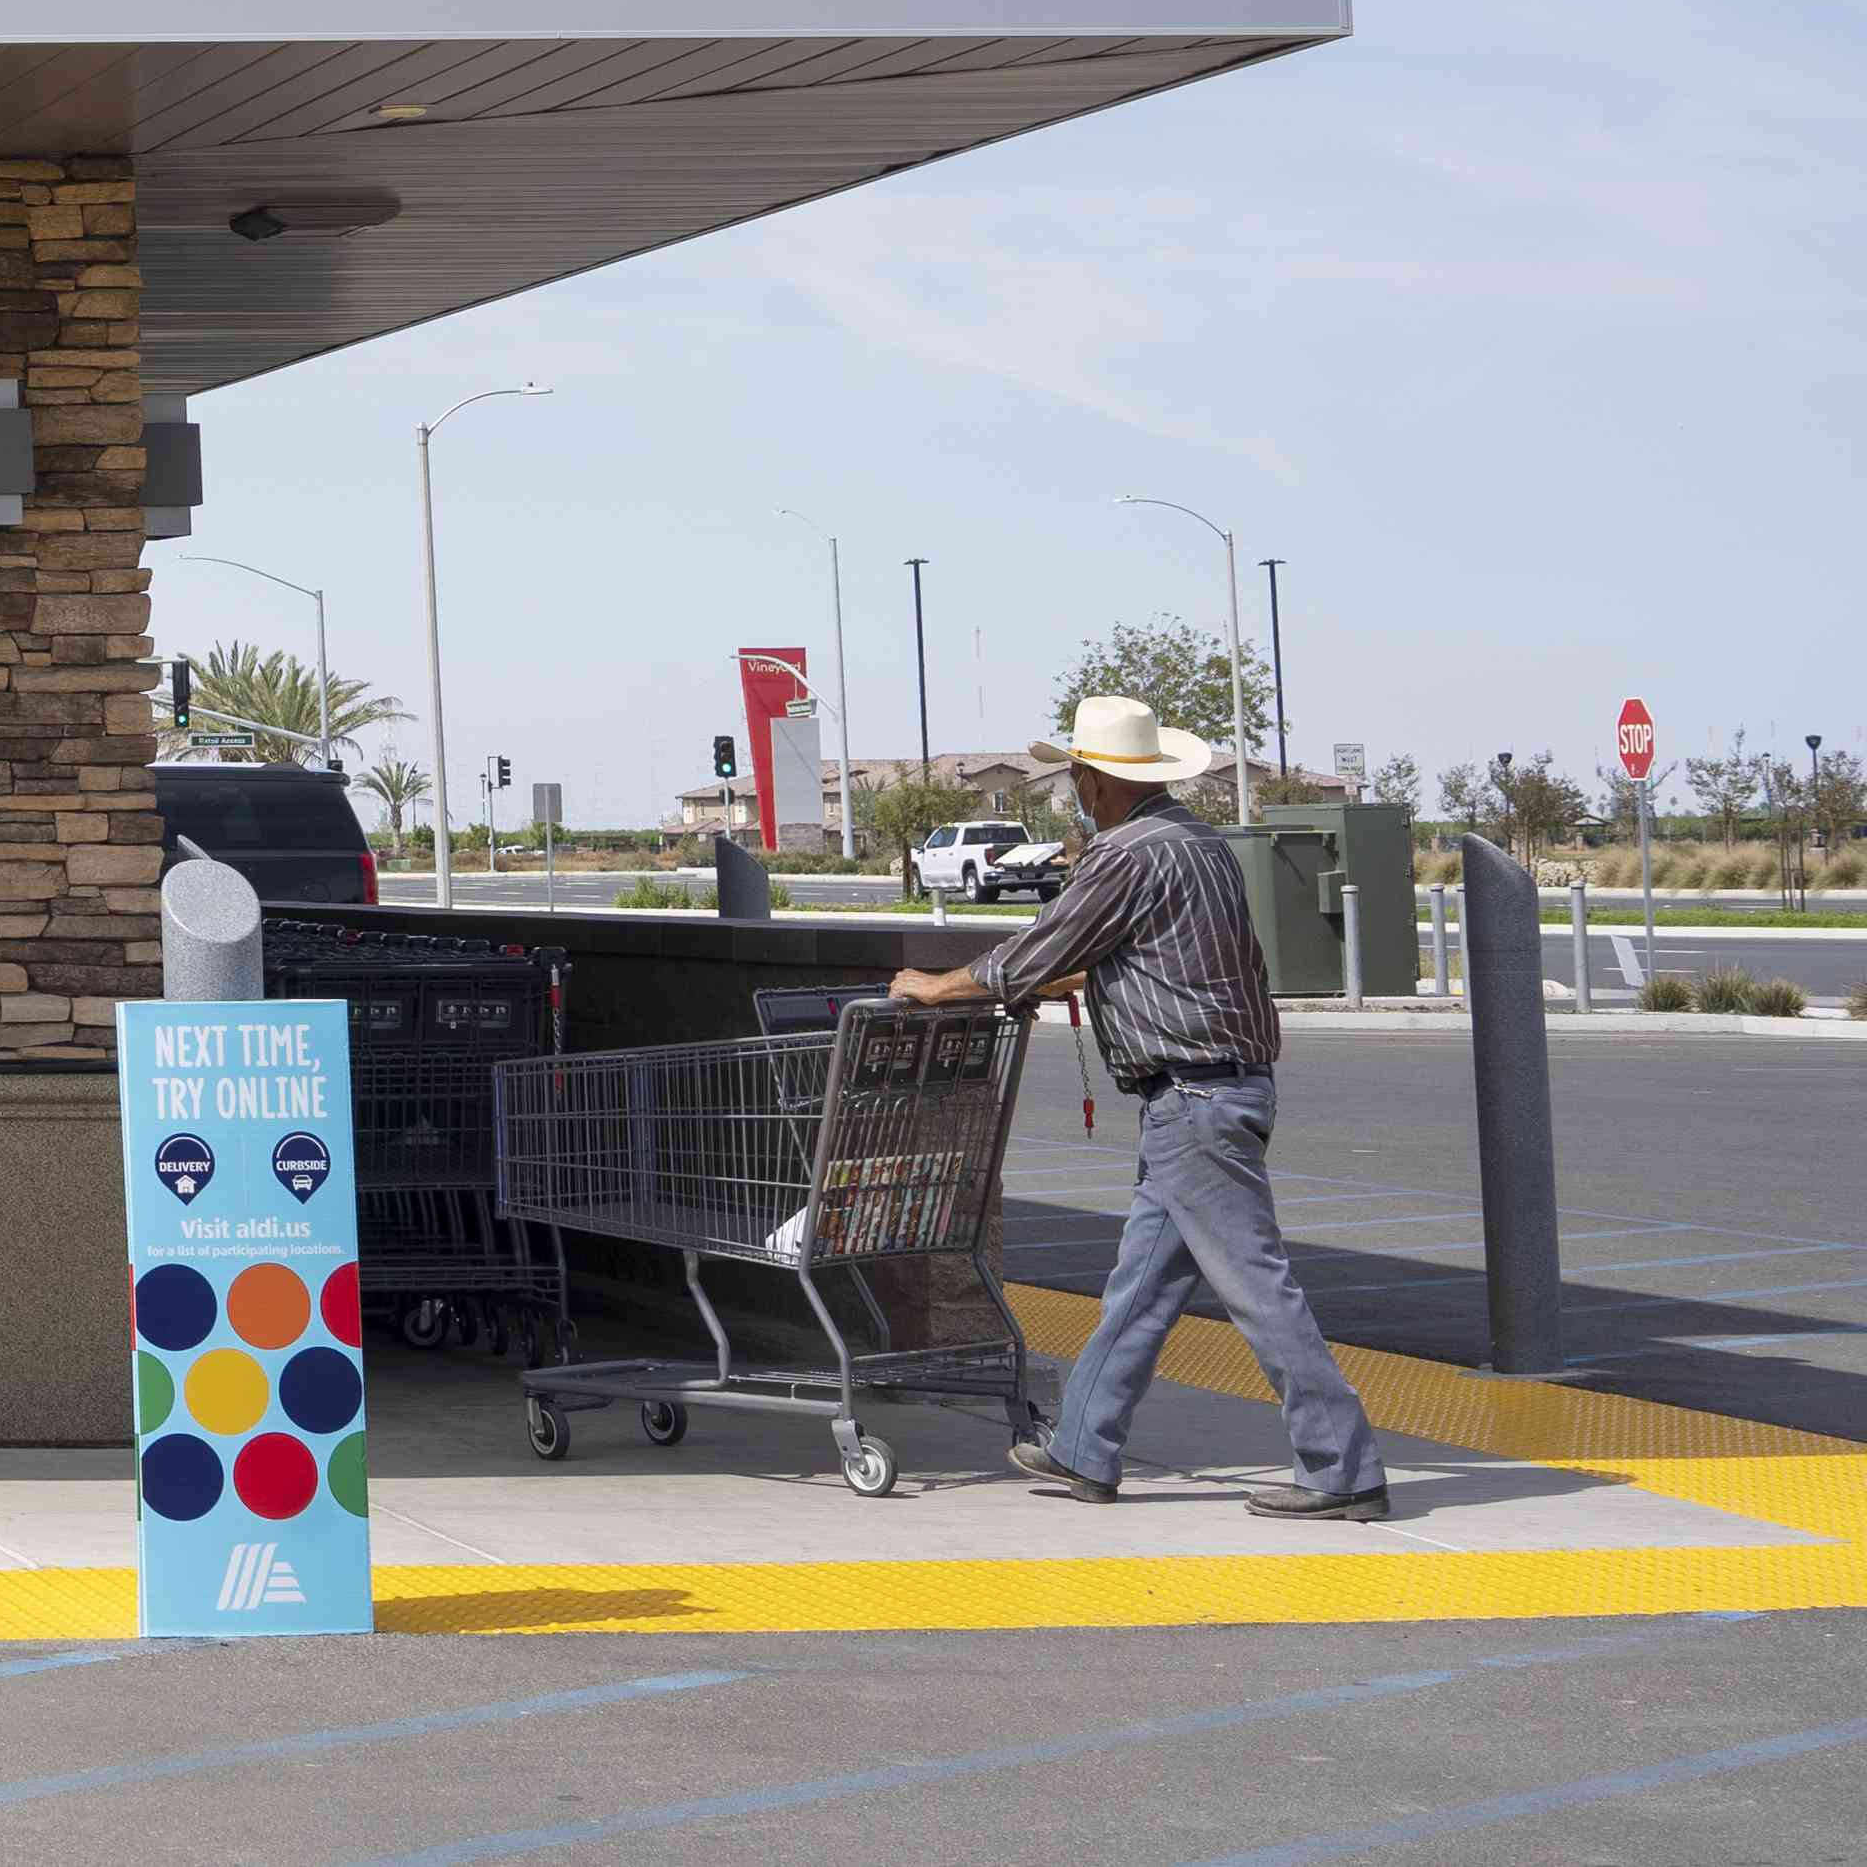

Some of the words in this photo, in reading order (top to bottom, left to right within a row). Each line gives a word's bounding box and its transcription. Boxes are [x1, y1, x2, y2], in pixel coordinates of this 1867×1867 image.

[747, 661, 801, 674] Vineyd
[1620, 724, 1652, 754] STOP
[153, 1025, 227, 1068] NEXT
[237, 1024, 321, 1072] TIME,
[151, 1077, 205, 1119] TRY
[216, 1075, 328, 1119] ONLINE
[159, 1161, 211, 1173] DELIVERY
[276, 1159, 327, 1171] CURBSIDE
[180, 1217, 230, 1238] Visit
[235, 1216, 311, 1238] aldi.us
[147, 1245, 164, 1256] for
[166, 1247, 175, 1256] a
[177, 1245, 195, 1256] list
[198, 1245, 210, 1256] of
[212, 1244, 288, 1258] participating
[290, 1243, 345, 1255] locations.
